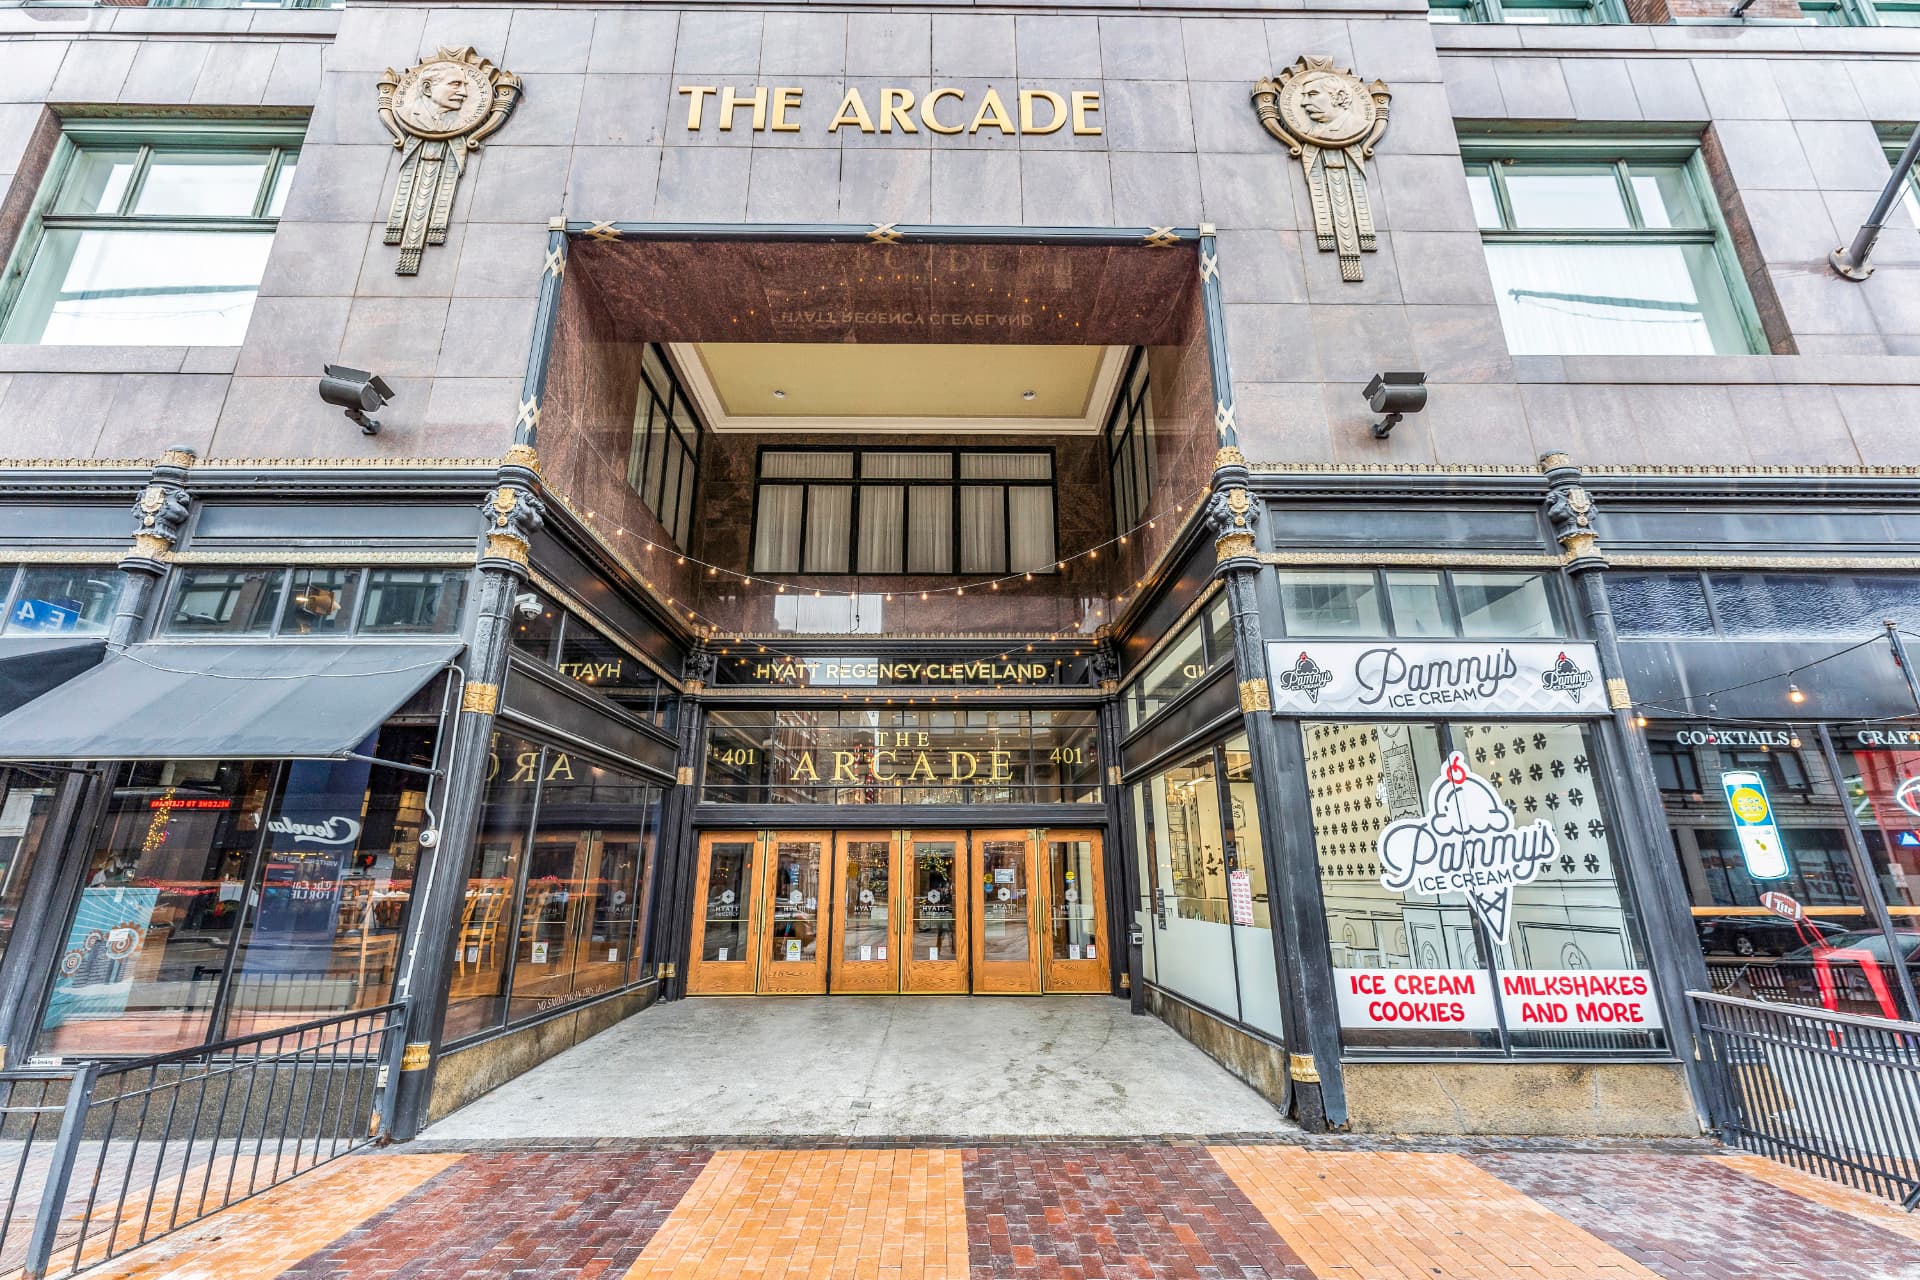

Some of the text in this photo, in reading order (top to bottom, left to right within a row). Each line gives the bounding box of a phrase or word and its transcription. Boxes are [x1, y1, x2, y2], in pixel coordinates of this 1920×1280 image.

[679, 86, 1102, 136] THE ARCADE
[756, 663, 1047, 679] HYATT REGENCY CLEVELAND
[1355, 647, 1517, 705] Pammy's
[1388, 687, 1477, 708] ICE CREAM
[878, 731, 930, 747] THE
[1676, 730, 1790, 745] COCKTAILS
[721, 748, 756, 765] 401
[790, 750, 1014, 781] ARCADE
[1050, 747, 1083, 764] 401
[1383, 821, 1555, 888] Pammy's
[1418, 869, 1513, 892] ICE CREAM
[1350, 974, 1475, 996] ICE CREAM
[1503, 975, 1648, 997] MILKSHAKES
[1368, 1001, 1465, 1022] COOKIES
[1522, 1002, 1644, 1023] AND MORE
